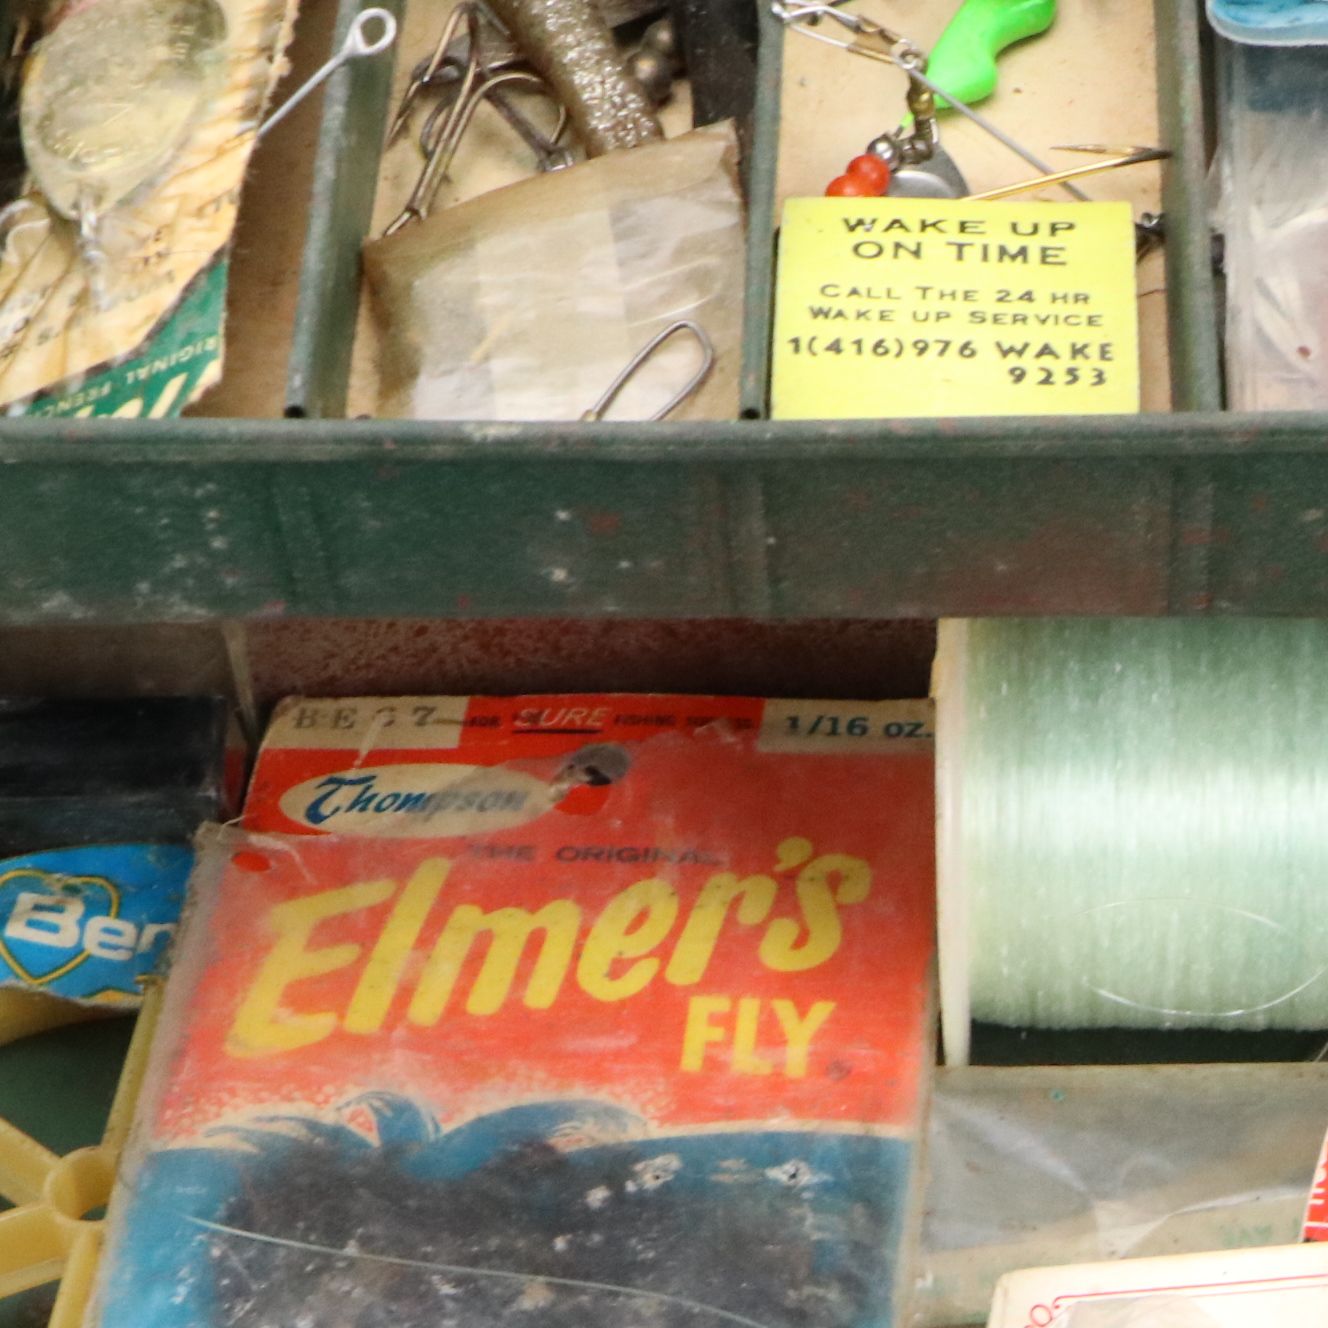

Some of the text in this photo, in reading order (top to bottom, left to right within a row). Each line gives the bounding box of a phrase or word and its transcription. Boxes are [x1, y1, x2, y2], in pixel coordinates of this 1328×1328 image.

[843, 217, 1078, 238] WAKE UP
[853, 241, 1067, 266] ON TIME
[820, 283, 1091, 306] CALL THE 24 HR
[808, 304, 1104, 328] WAKE UP SERVICE
[126, 336, 219, 385] RIGINAL
[787, 334, 1115, 363] 1(416)976 WAKE
[1008, 366, 1108, 387] 9253
[512, 706, 612, 729] SURE
[786, 715, 934, 739] 1/16 oz.
[304, 774, 529, 826] Thompson
[555, 845, 726, 866] ORIGINAL
[223, 836, 873, 1059] Elmer's
[680, 996, 837, 1079] FLY
